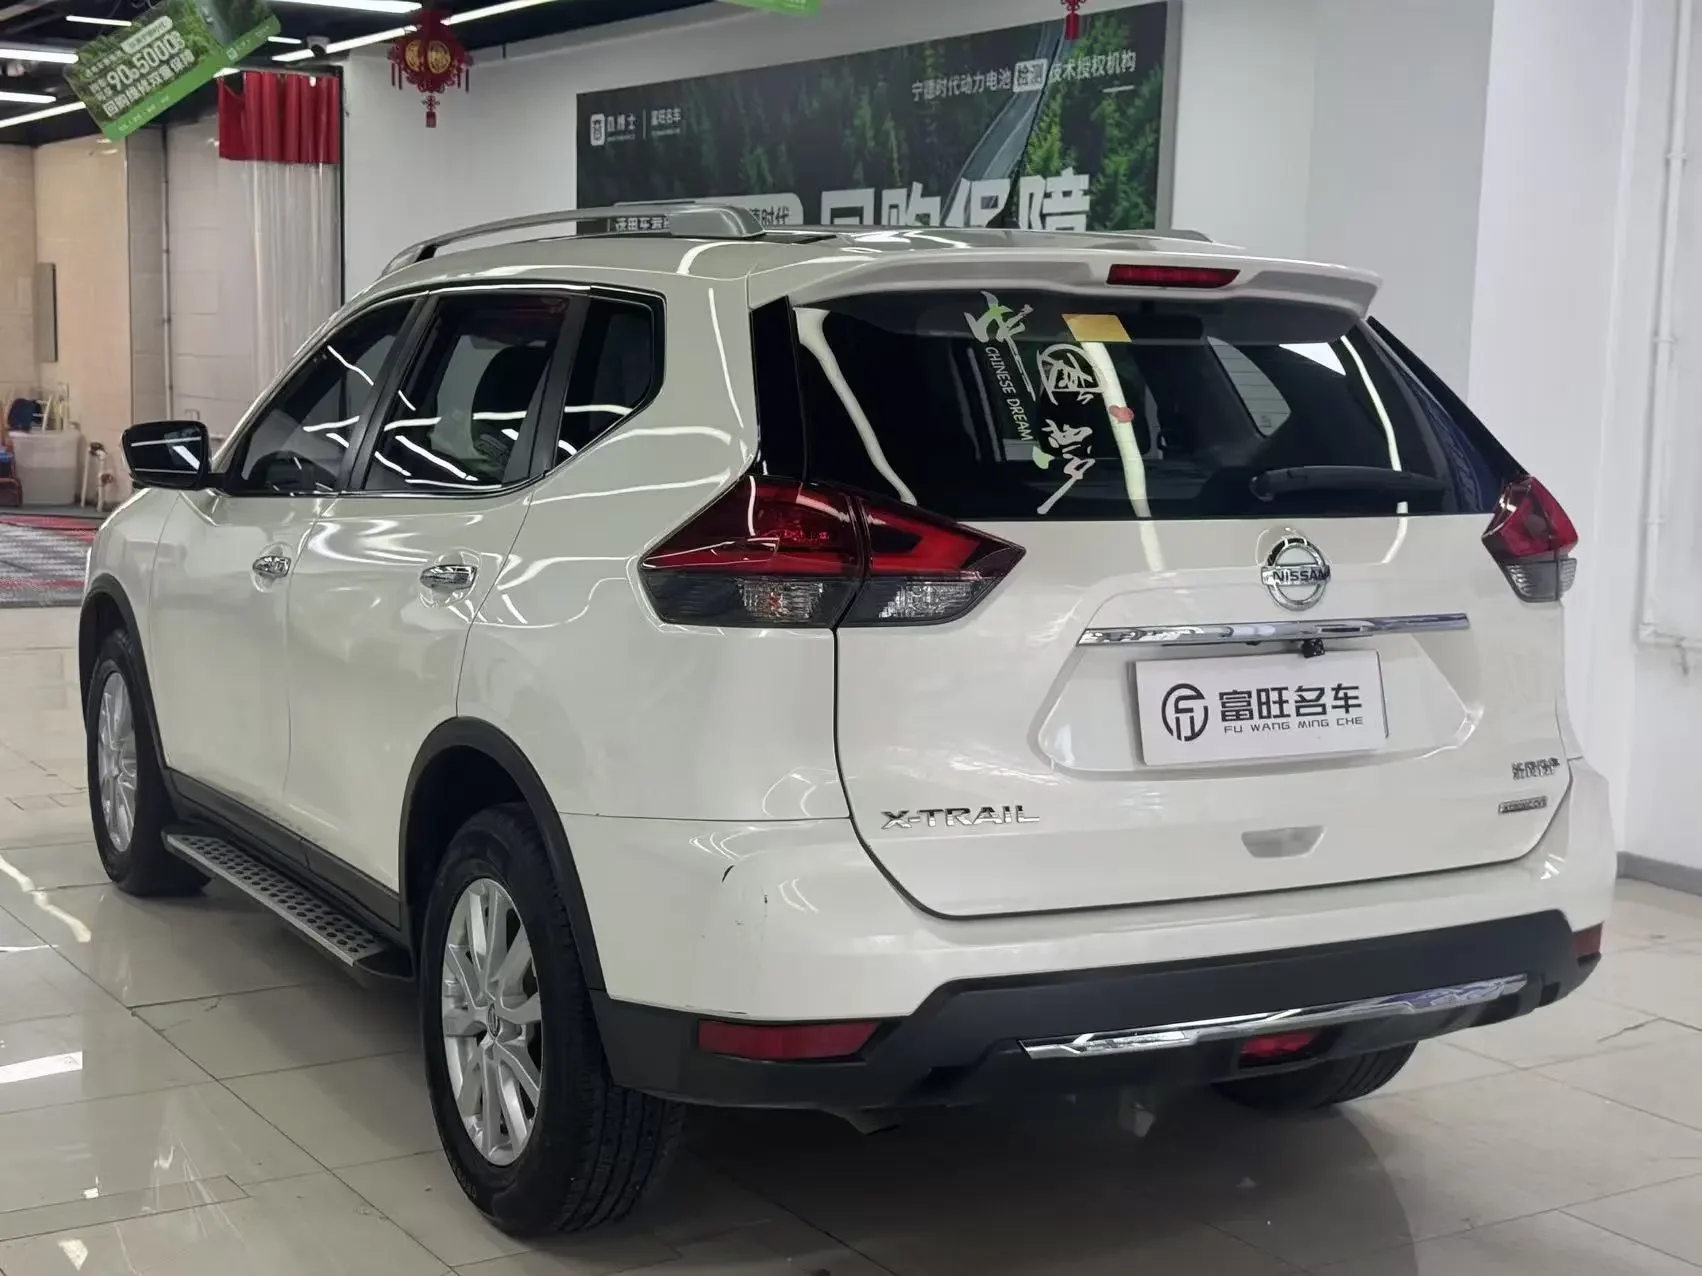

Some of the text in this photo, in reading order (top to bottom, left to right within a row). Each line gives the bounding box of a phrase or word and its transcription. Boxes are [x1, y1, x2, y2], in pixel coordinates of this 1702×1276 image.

[985, 346, 1034, 441] CHINESE DREAM
[1272, 566, 1330, 582] NISSAN
[1218, 683, 1362, 722] 富旺名车
[1223, 716, 1364, 734] FU WANG MING CHE
[881, 805, 1041, 830] X-TRAIL
